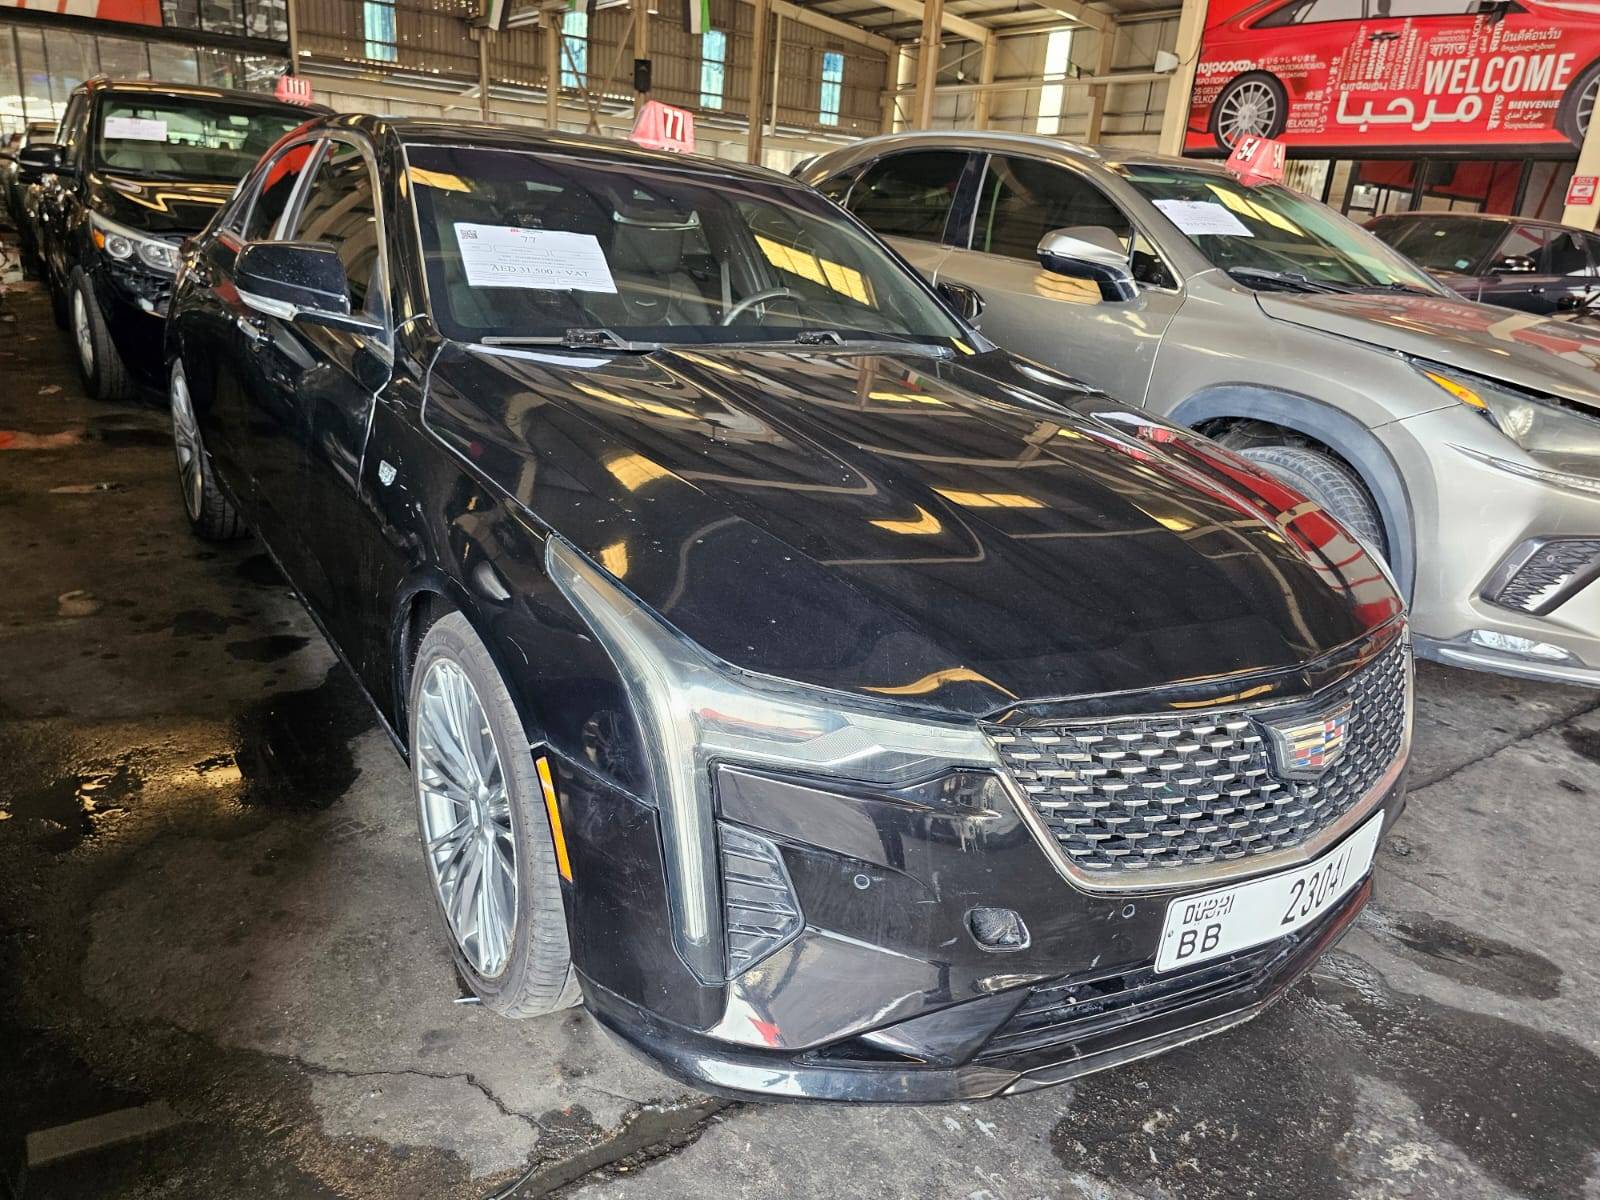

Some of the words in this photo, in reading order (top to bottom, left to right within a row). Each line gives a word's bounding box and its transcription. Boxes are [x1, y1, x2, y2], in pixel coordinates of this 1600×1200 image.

[288, 79, 307, 96] 111
[1423, 53, 1576, 95] WELCOME
[1335, 91, 1482, 132] مرحبا
[1508, 99, 1560, 110] BIENVENUE
[663, 107, 684, 143] 77
[1236, 138, 1261, 162] 54
[1281, 846, 1353, 926] 23041
[1176, 922, 1222, 960] BB
